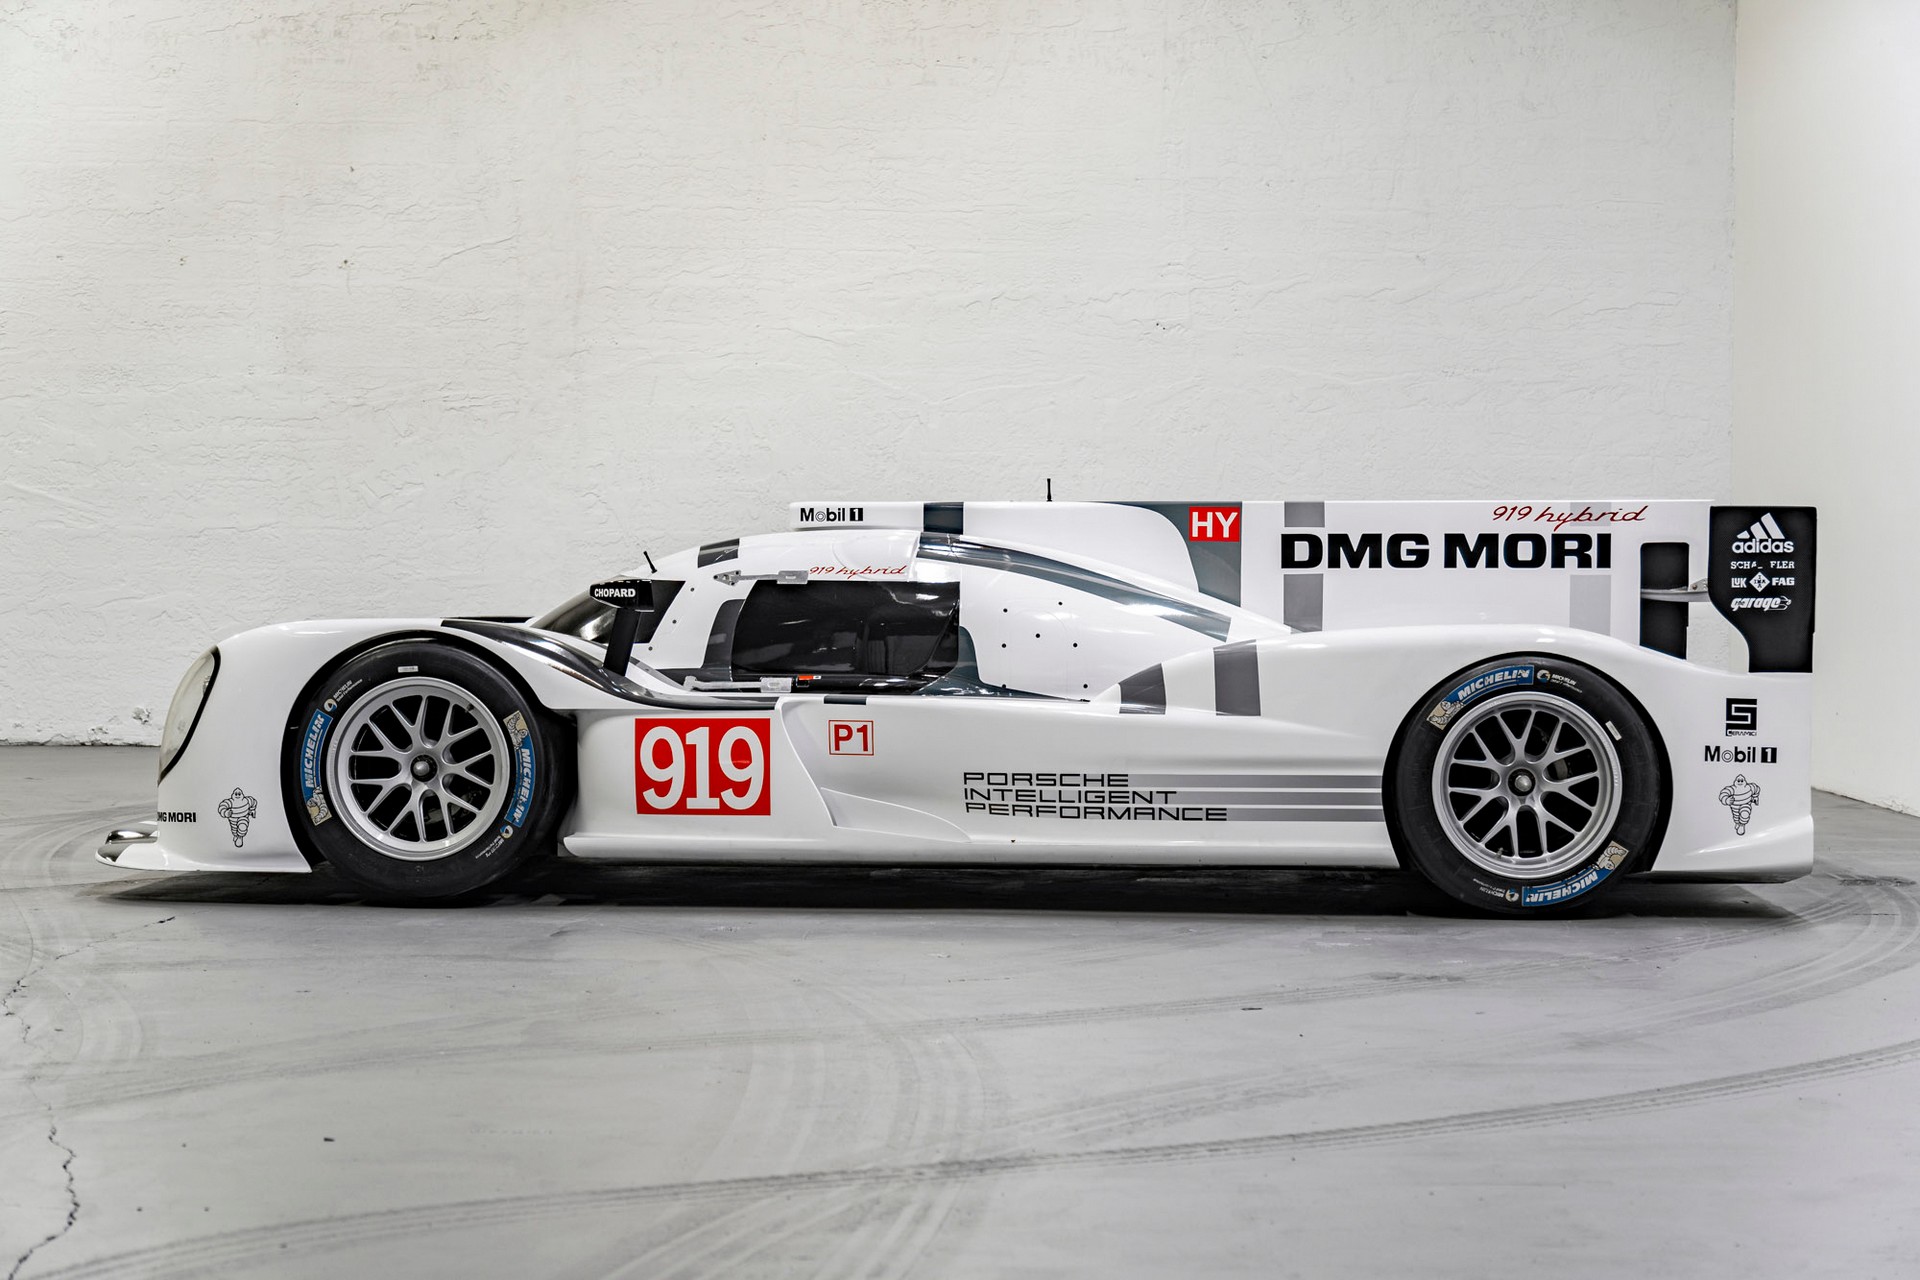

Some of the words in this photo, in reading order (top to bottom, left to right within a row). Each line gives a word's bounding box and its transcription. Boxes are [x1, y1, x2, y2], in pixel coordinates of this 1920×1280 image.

[800, 508, 845, 522] Mobil
[1493, 505, 1532, 521] 919
[1533, 505, 1649, 532] hybrid
[1192, 511, 1238, 538] HY
[1281, 533, 1430, 569] DMG
[1444, 533, 1611, 569] MORI
[1731, 538, 1794, 554] adidas
[809, 566, 835, 574] 919
[835, 565, 907, 579] hybrid
[1771, 577, 1795, 586] FAG
[594, 588, 636, 597] CHOPARD
[1730, 597, 1782, 611] garage
[1457, 669, 1531, 701] MICHELIN
[834, 724, 868, 751] P1
[305, 714, 325, 788] MICHELIN
[1704, 745, 1756, 763] Mobil
[640, 726, 765, 810] 919
[964, 772, 1129, 787] PORSCHE
[964, 788, 1177, 804] INTELLIGENT
[168, 812, 197, 822] MORI
[966, 802, 1227, 821] PERFORMANCE
[1525, 871, 1598, 902] MICHELIN
